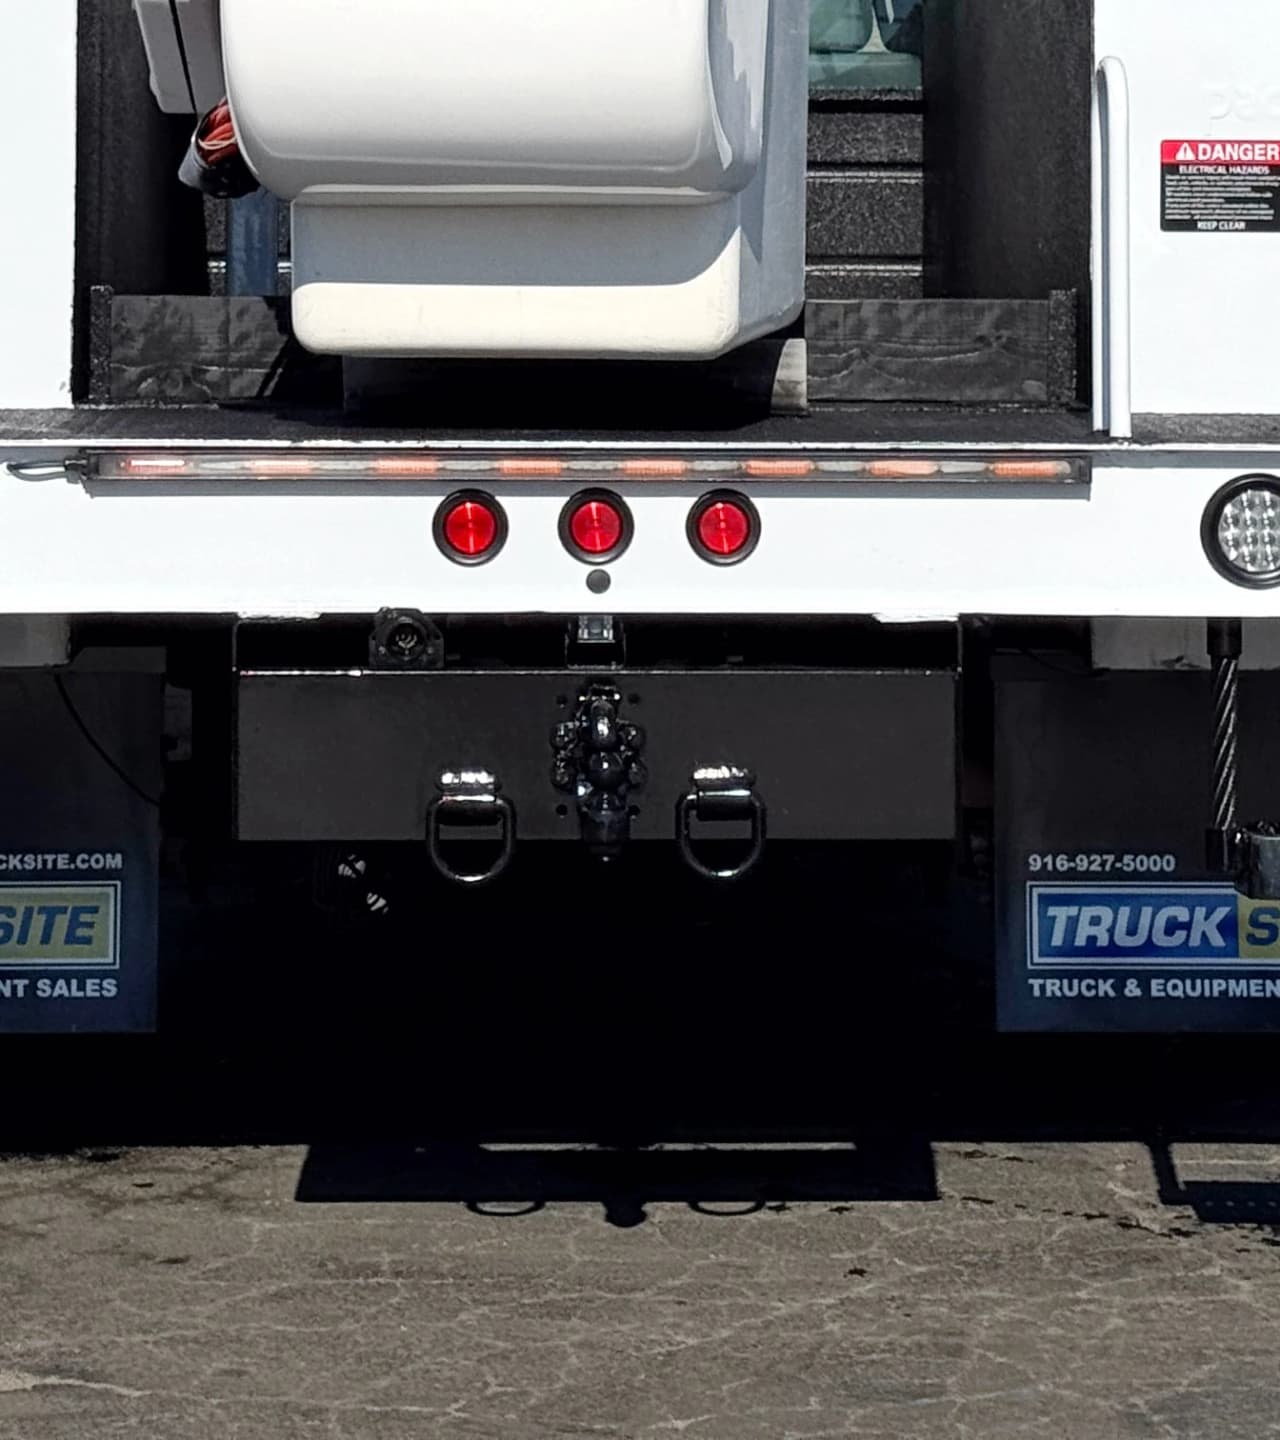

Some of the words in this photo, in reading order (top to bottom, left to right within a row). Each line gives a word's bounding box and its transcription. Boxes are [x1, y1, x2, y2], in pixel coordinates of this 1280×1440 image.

[1197, 143, 1280, 161] DANGER
[1179, 165, 1227, 174] ELECTRICAL
[1229, 165, 1270, 174] HAZARDS
[1197, 221, 1218, 230] KEEP
[1219, 221, 1247, 230] CLEAR
[1028, 854, 1176, 873] 916-927-5000
[1046, 905, 1232, 948] TRUCK
[36, 978, 118, 997] SALES
[1028, 978, 1116, 998] TRUCK
[1123, 978, 1142, 998] &
